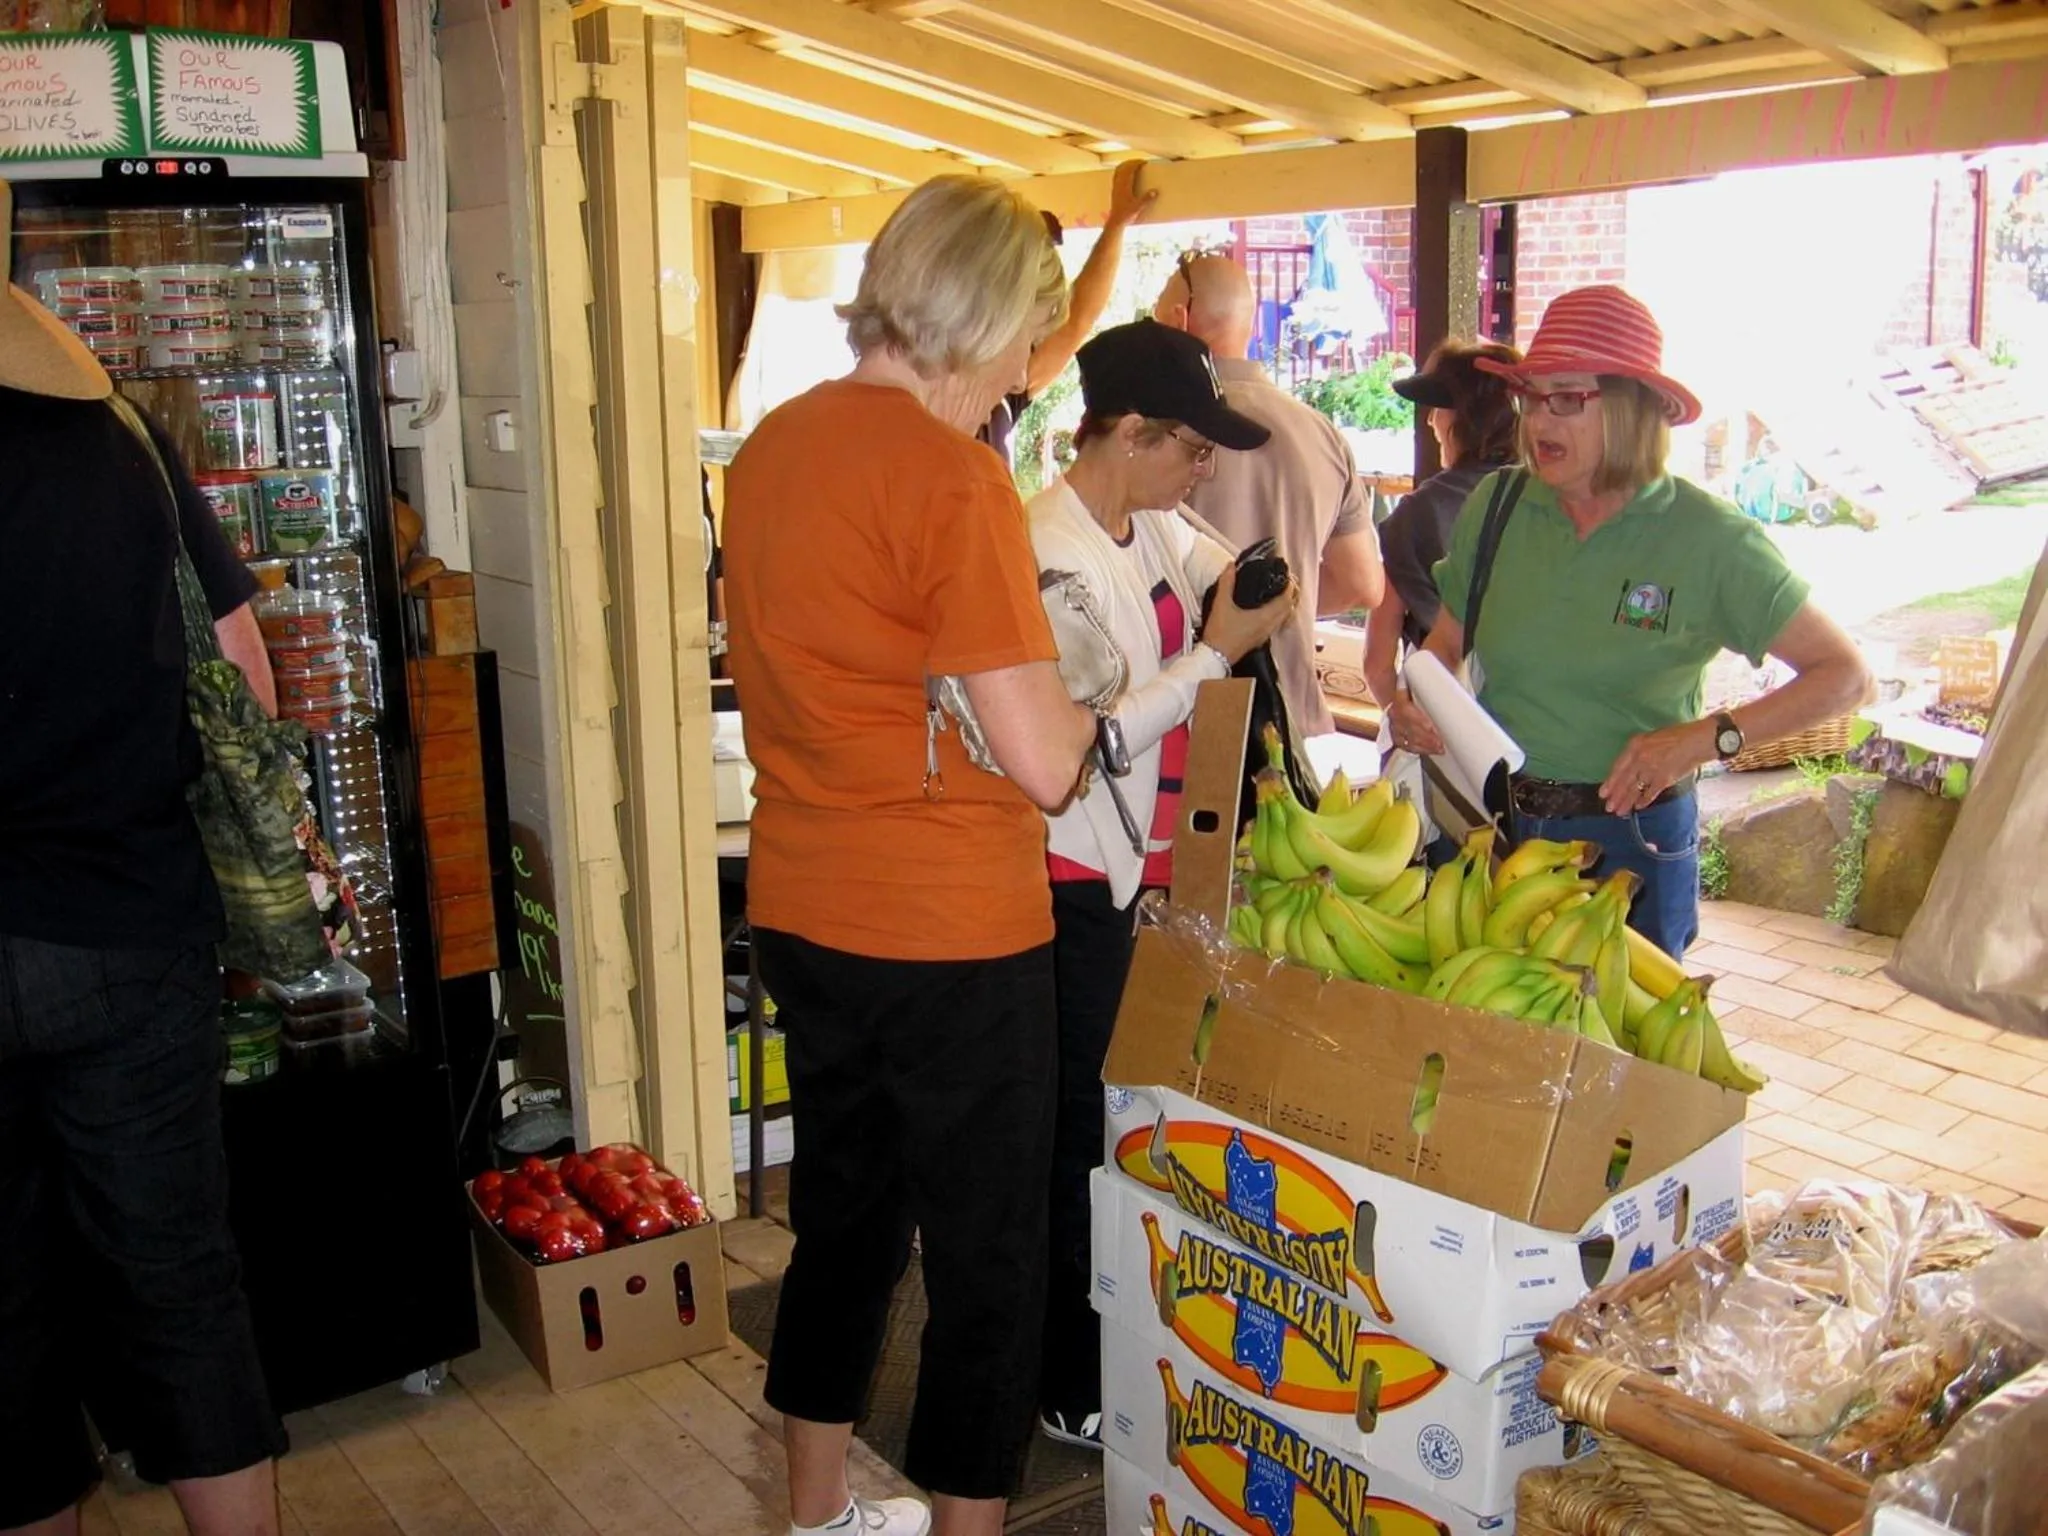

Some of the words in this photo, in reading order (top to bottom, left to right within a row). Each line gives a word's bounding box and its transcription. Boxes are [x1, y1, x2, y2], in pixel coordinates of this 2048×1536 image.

[180, 50, 240, 70] OUR
[1165, 1150, 1349, 1298] AUSTRALIAN
[1175, 1230, 1361, 1384] AUSTRALIAN
[1183, 1379, 1369, 1536] AUSTRALIAN
[1501, 1412, 1547, 1440] PRODUCT
[1504, 1420, 1558, 1448] AUSTRALIA
